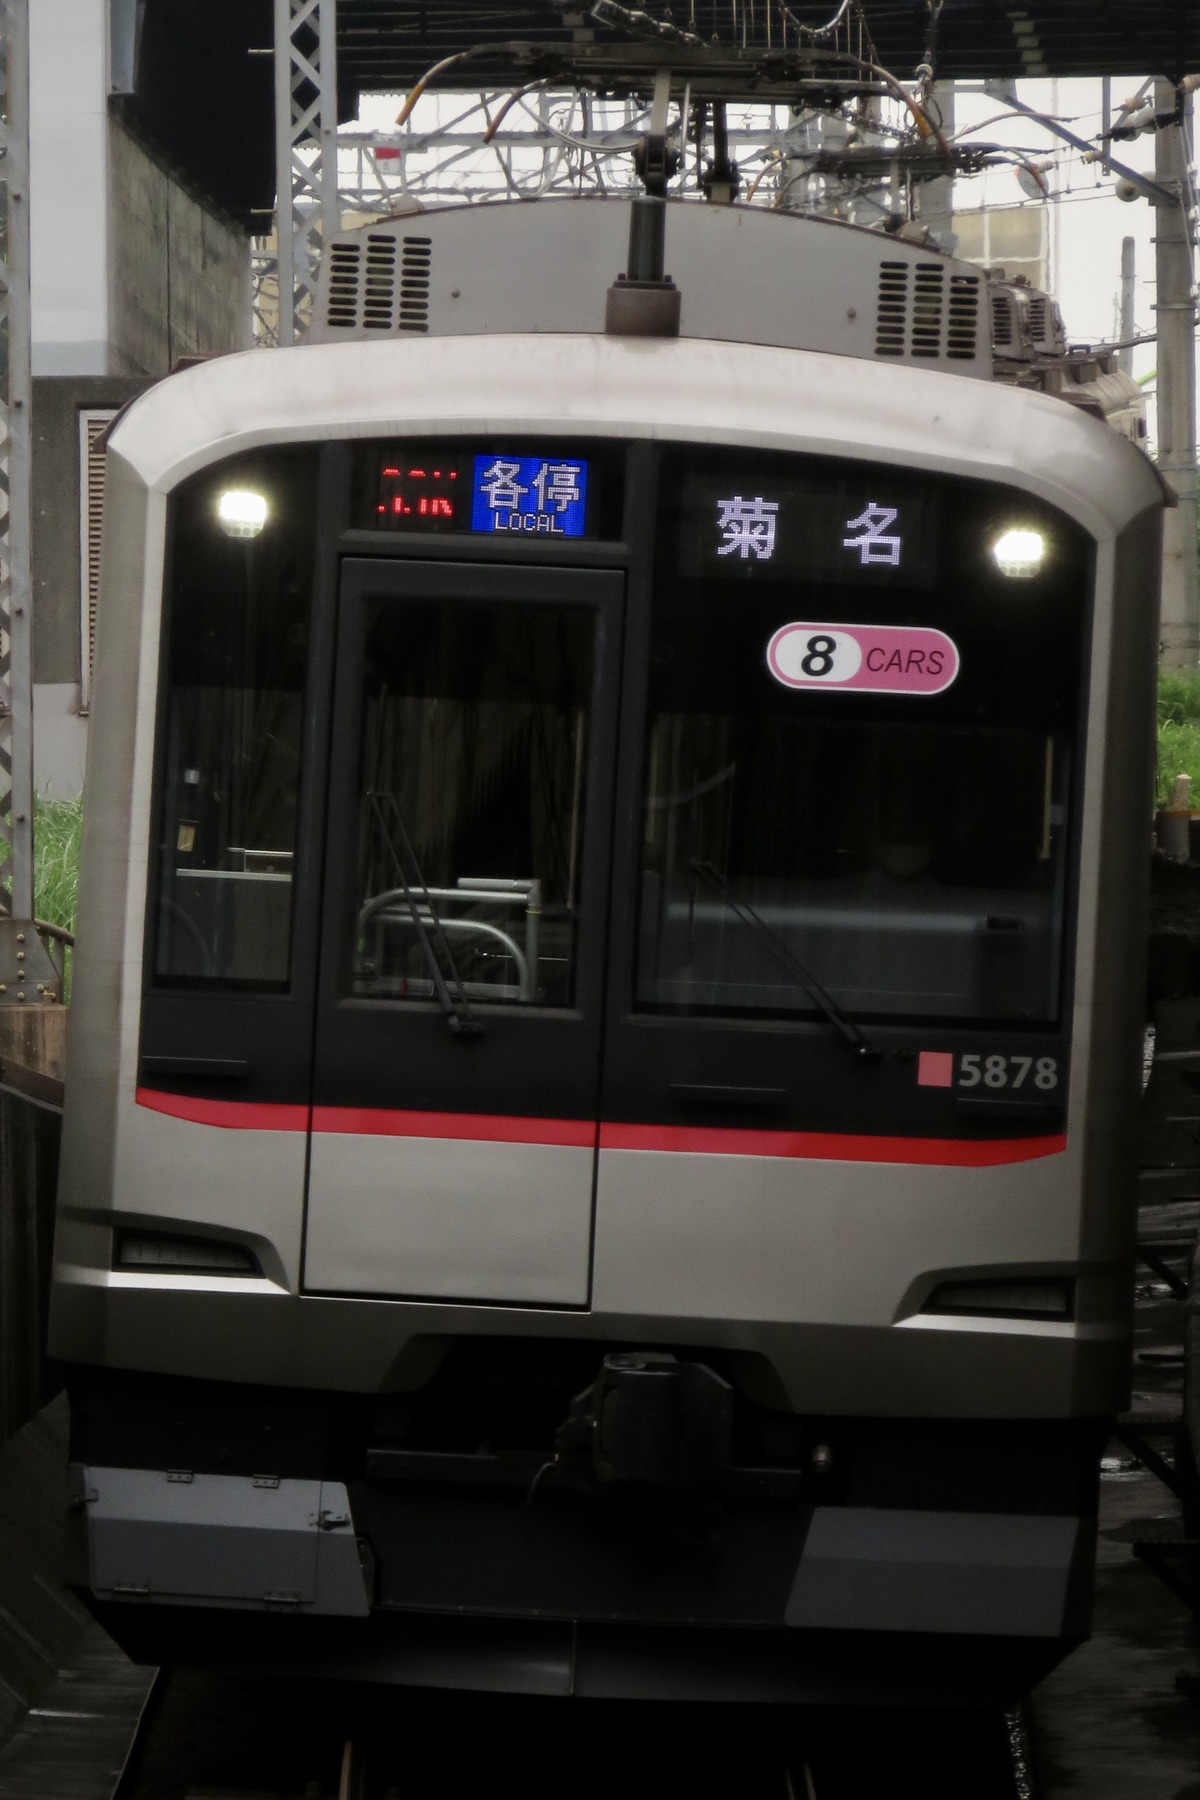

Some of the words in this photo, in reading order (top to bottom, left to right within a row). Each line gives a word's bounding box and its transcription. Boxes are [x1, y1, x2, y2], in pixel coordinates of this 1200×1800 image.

[480, 460, 581, 513] 各停
[495, 511, 564, 533] LOCAL
[717, 496, 901, 565] 菊名
[801, 635, 837, 677] 8
[866, 647, 945, 675] CARS
[958, 1054, 1058, 1090] 5878
